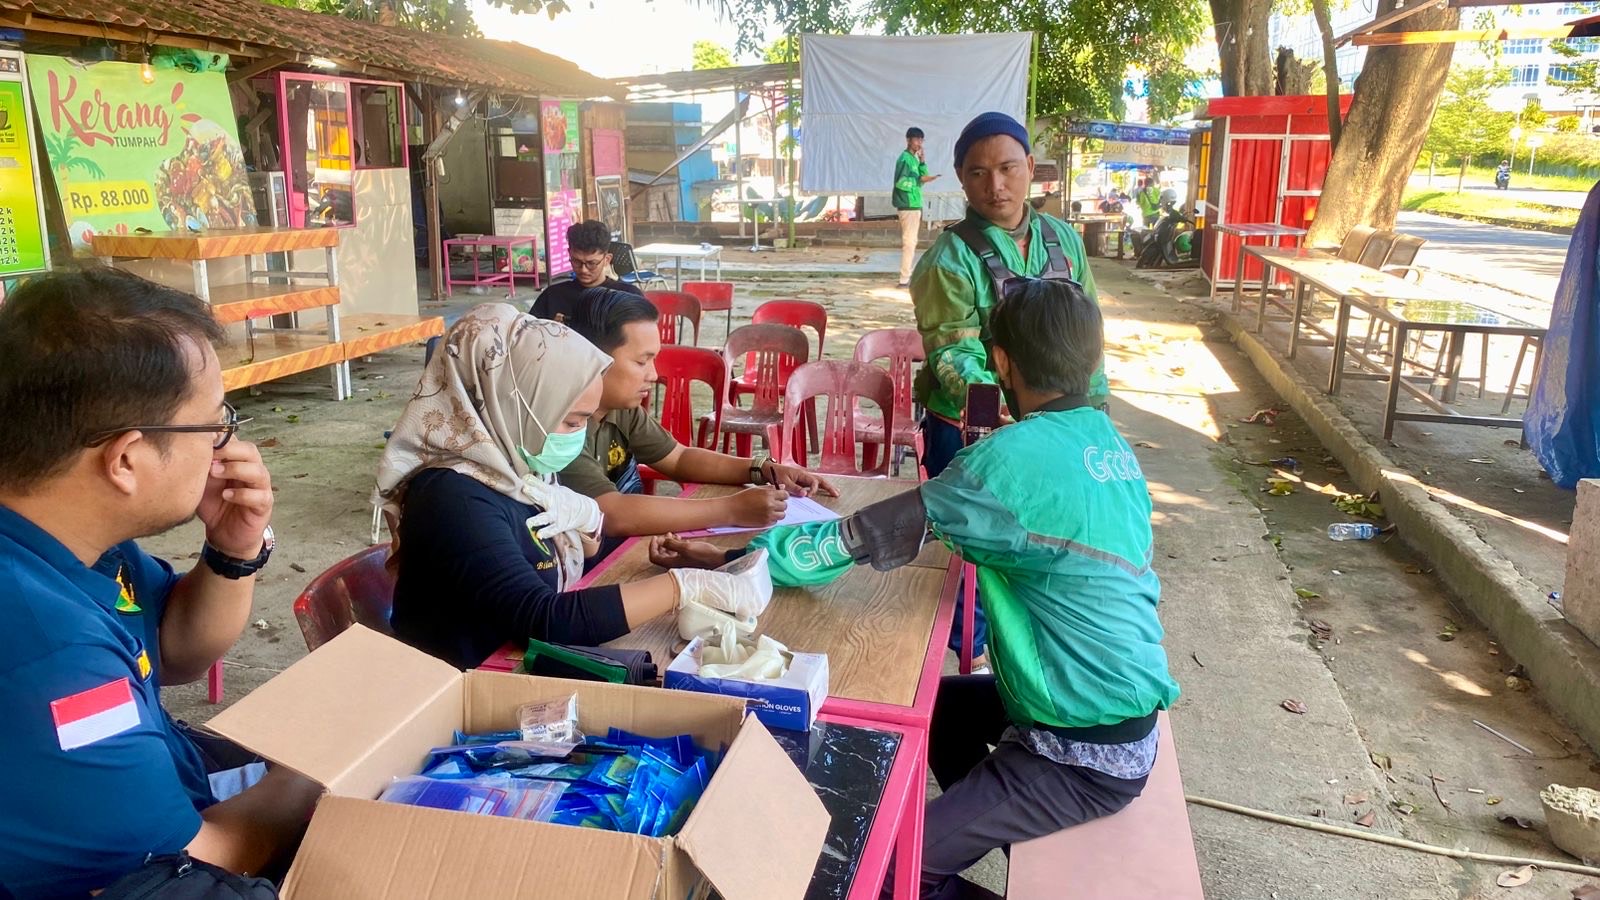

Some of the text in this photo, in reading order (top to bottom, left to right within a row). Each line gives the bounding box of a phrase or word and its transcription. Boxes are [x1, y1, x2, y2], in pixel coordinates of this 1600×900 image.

[48, 70, 174, 147] Kerang
[114, 136, 157, 148] TUMPAH
[70, 189, 150, 213] Rp. 88.000
[1083, 436, 1142, 482] Grab
[775, 704, 802, 713] GLOVES
